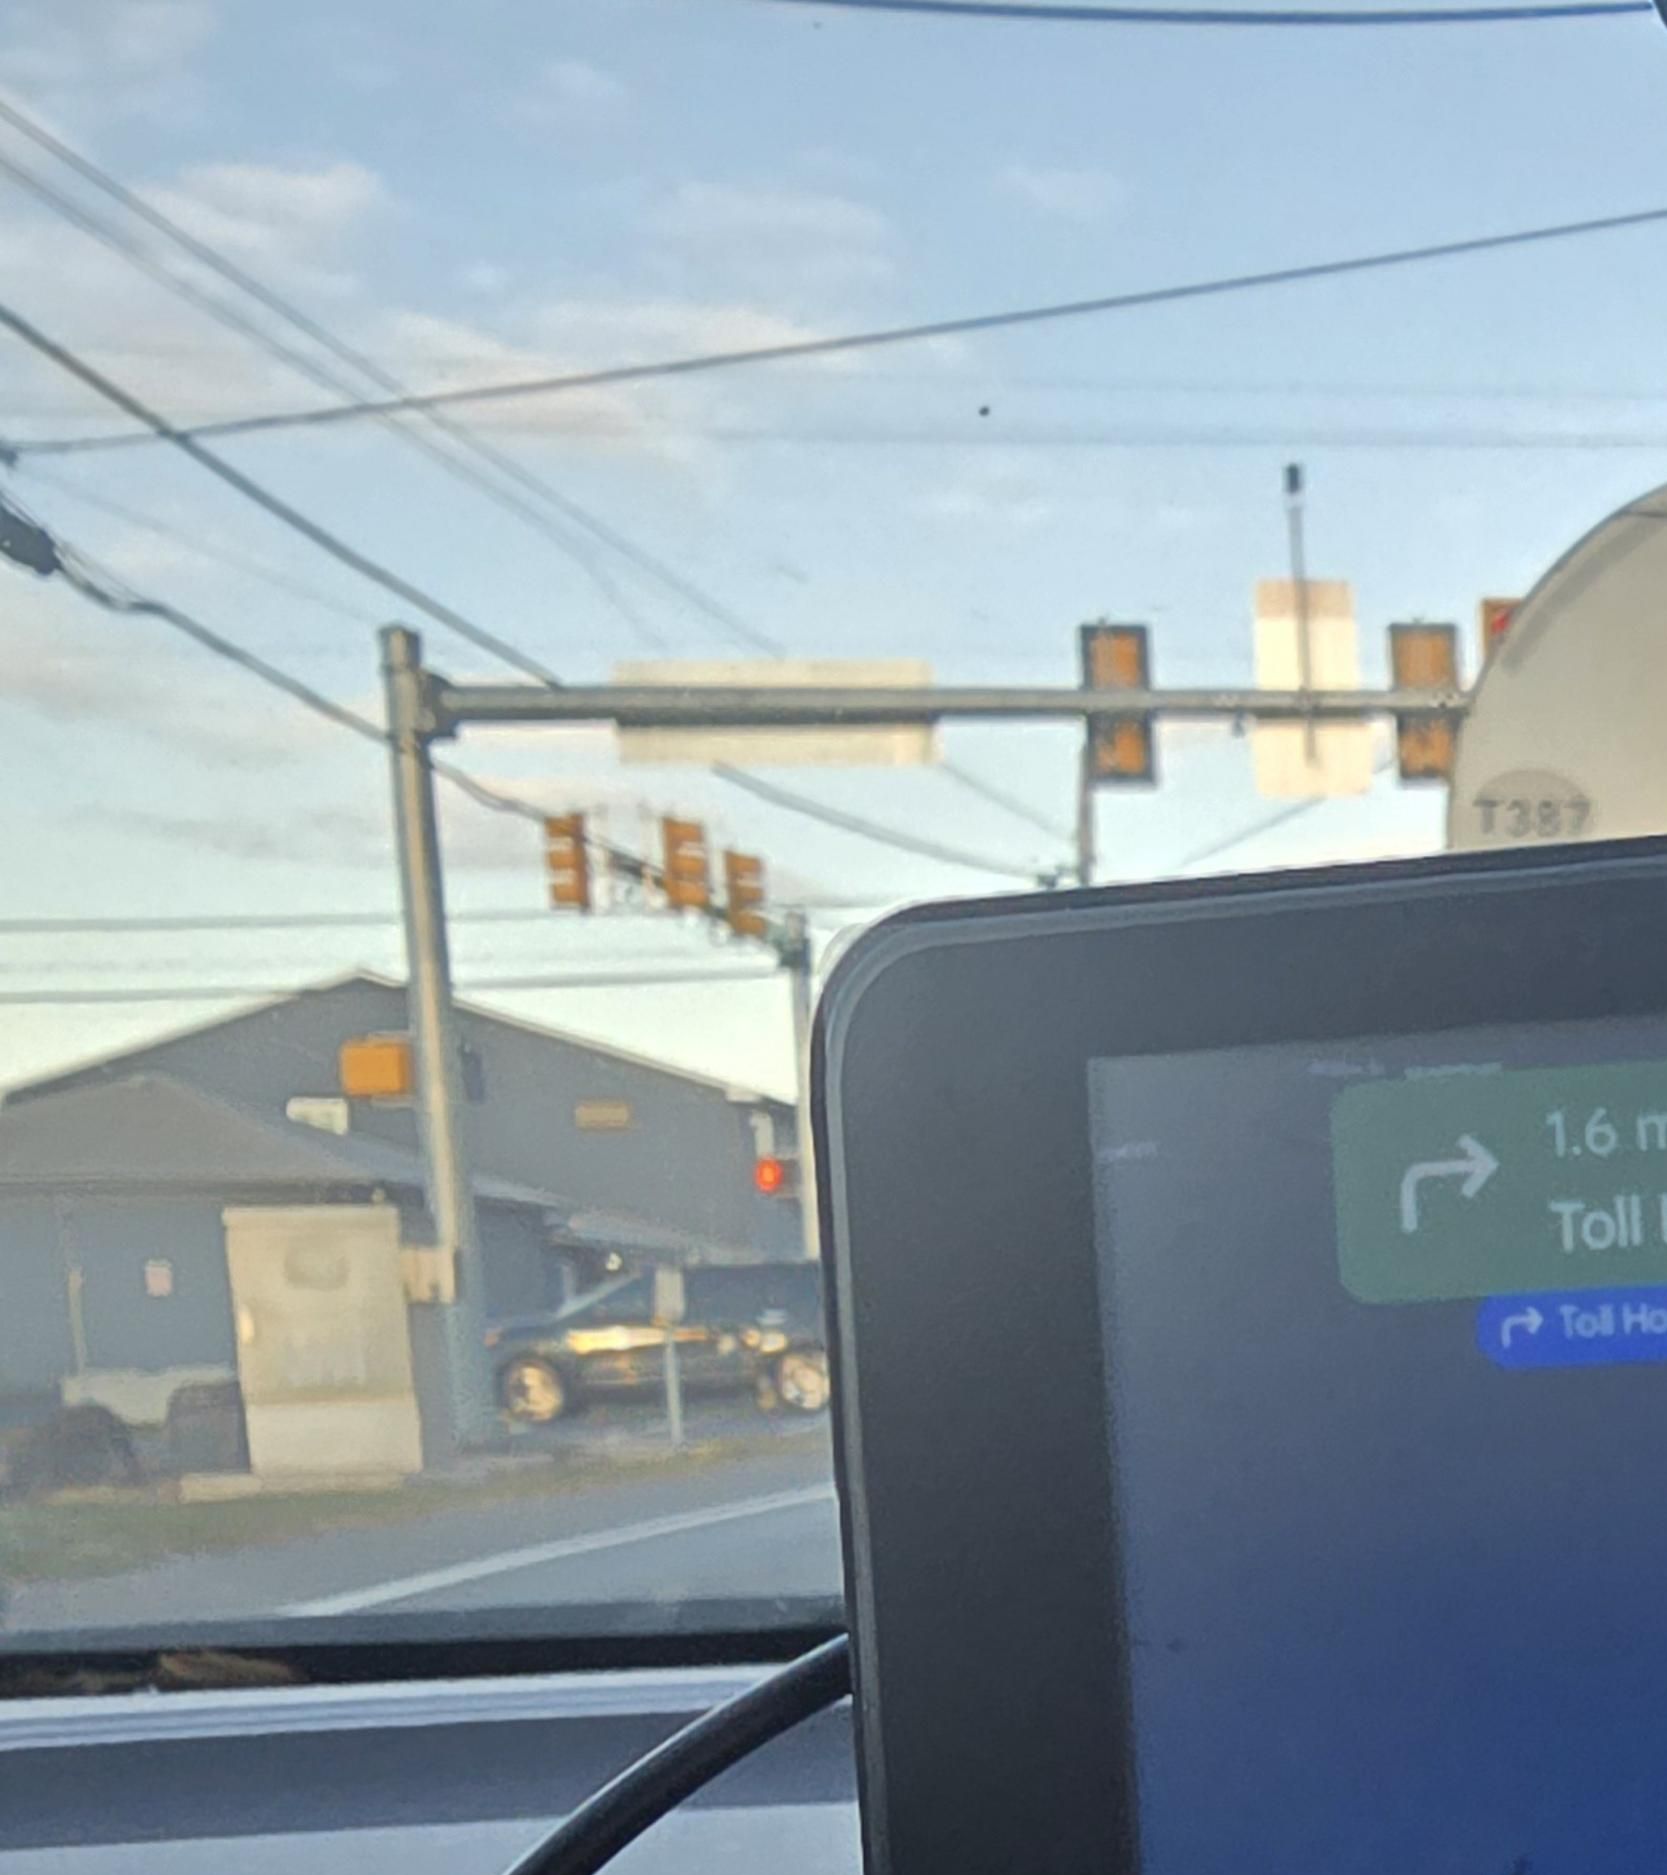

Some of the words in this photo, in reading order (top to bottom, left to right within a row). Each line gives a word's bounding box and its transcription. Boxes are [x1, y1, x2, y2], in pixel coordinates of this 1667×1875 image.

[1544, 1107, 1617, 1157] 1.6
[1549, 1196, 1640, 1255] Toll
[1559, 1302, 1616, 1339] Toll
